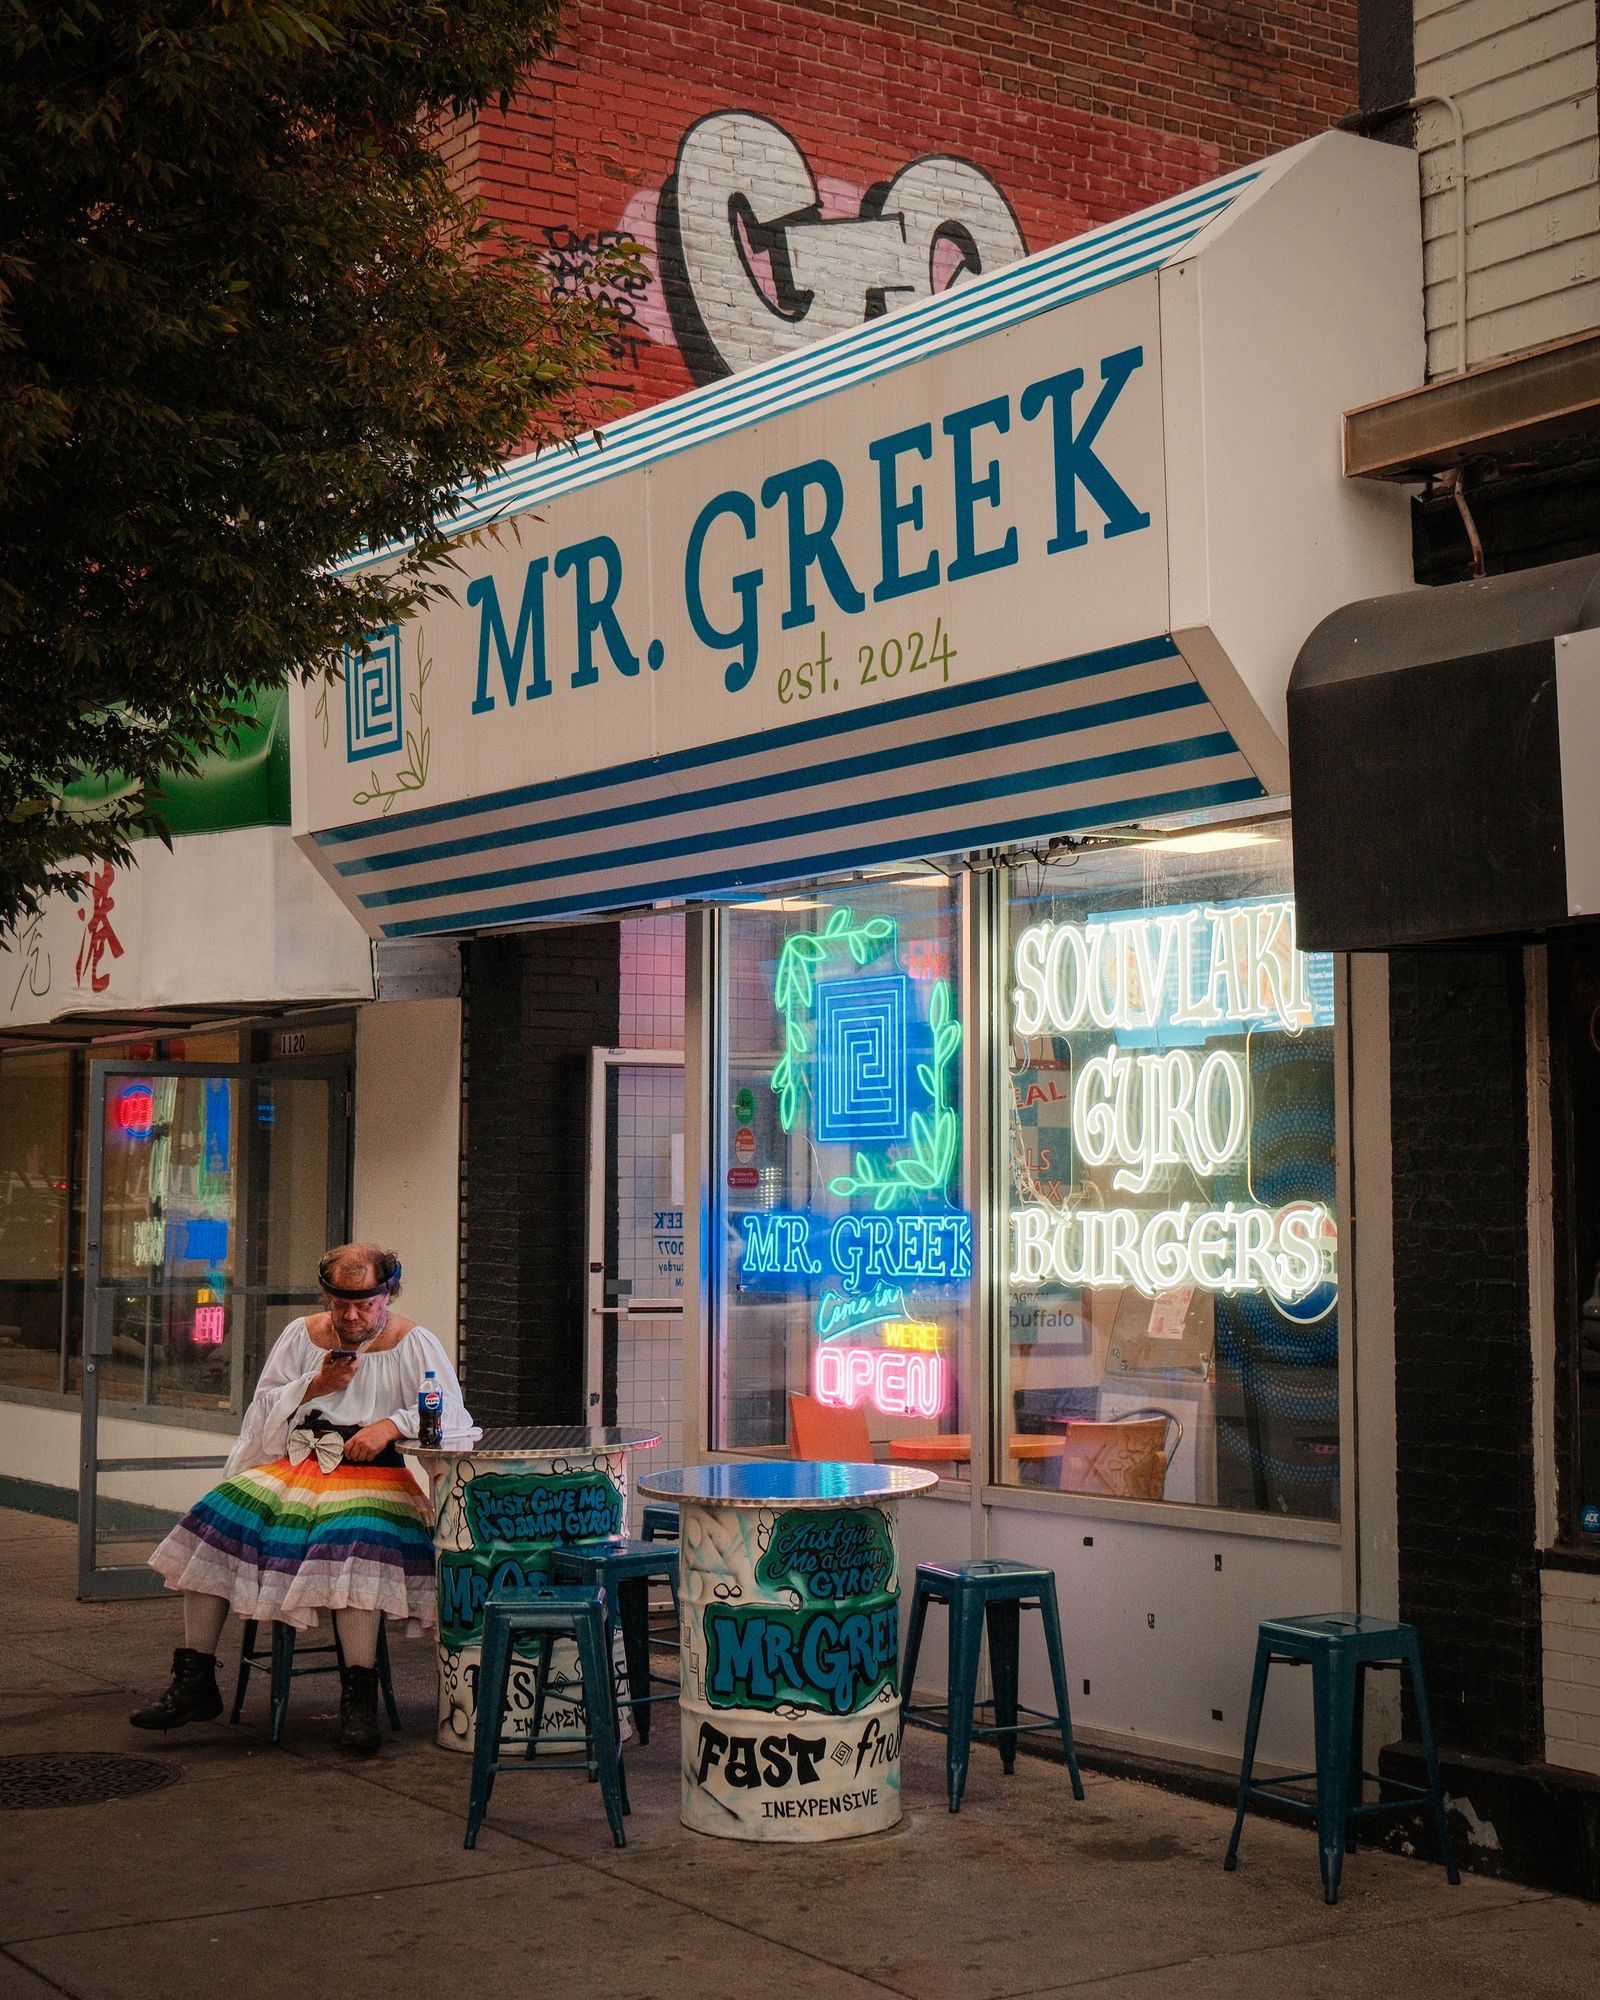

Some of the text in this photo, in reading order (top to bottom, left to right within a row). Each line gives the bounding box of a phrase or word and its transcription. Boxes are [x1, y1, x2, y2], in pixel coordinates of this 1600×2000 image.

[466, 344, 1151, 716] MR. GREEK
[776, 616, 958, 705] est. 2024
[1012, 900, 1313, 1034] SOUVLAKI
[281, 1033, 306, 1055] 1120
[1072, 1046, 1246, 1194] GYRO
[743, 1215, 971, 1292] MR. GREEK
[1009, 1201, 1325, 1301] BURGERS
[816, 1346, 941, 1418] OPEN
[760, 1788, 879, 1819] INEXPENSIVE
